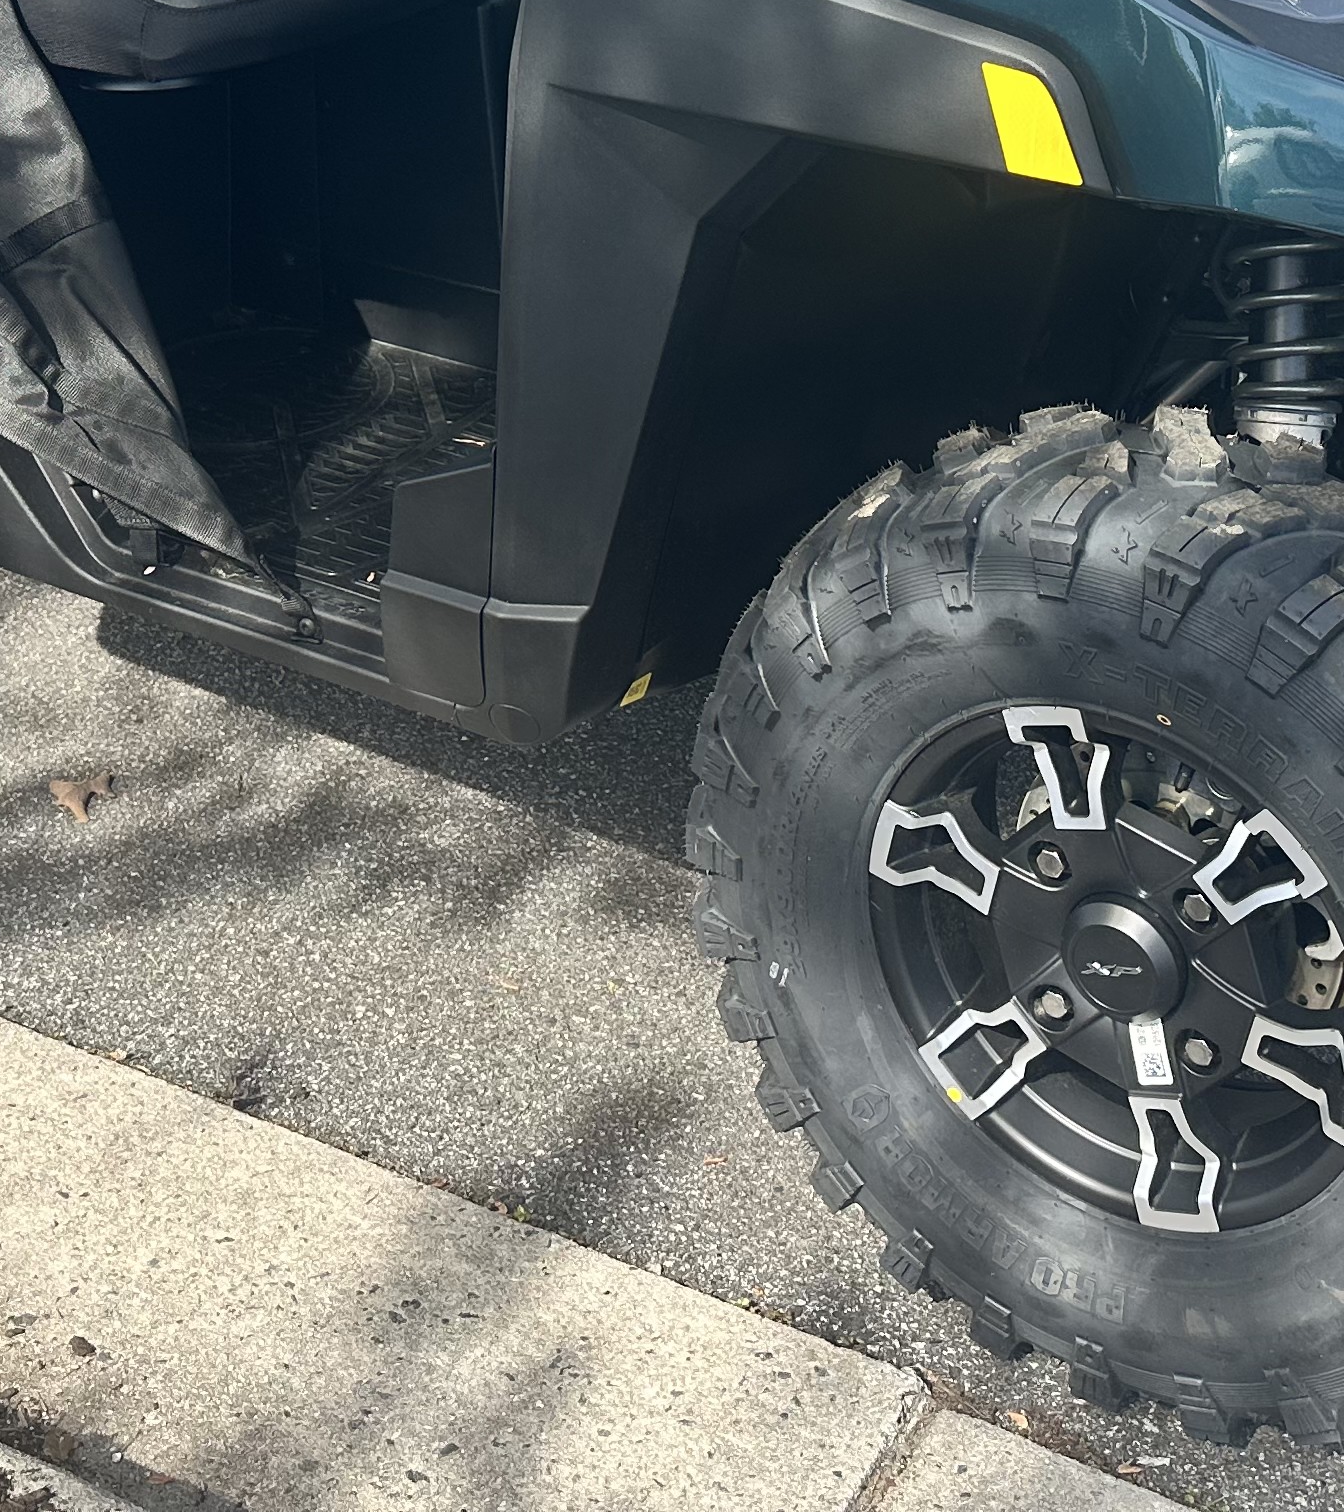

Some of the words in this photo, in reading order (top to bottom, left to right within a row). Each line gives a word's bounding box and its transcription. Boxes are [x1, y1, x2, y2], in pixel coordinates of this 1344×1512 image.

[1080, 961, 1143, 977] XP
[874, 1125, 1028, 1269] ARMOR
[1030, 1256, 1126, 1324] PRO
